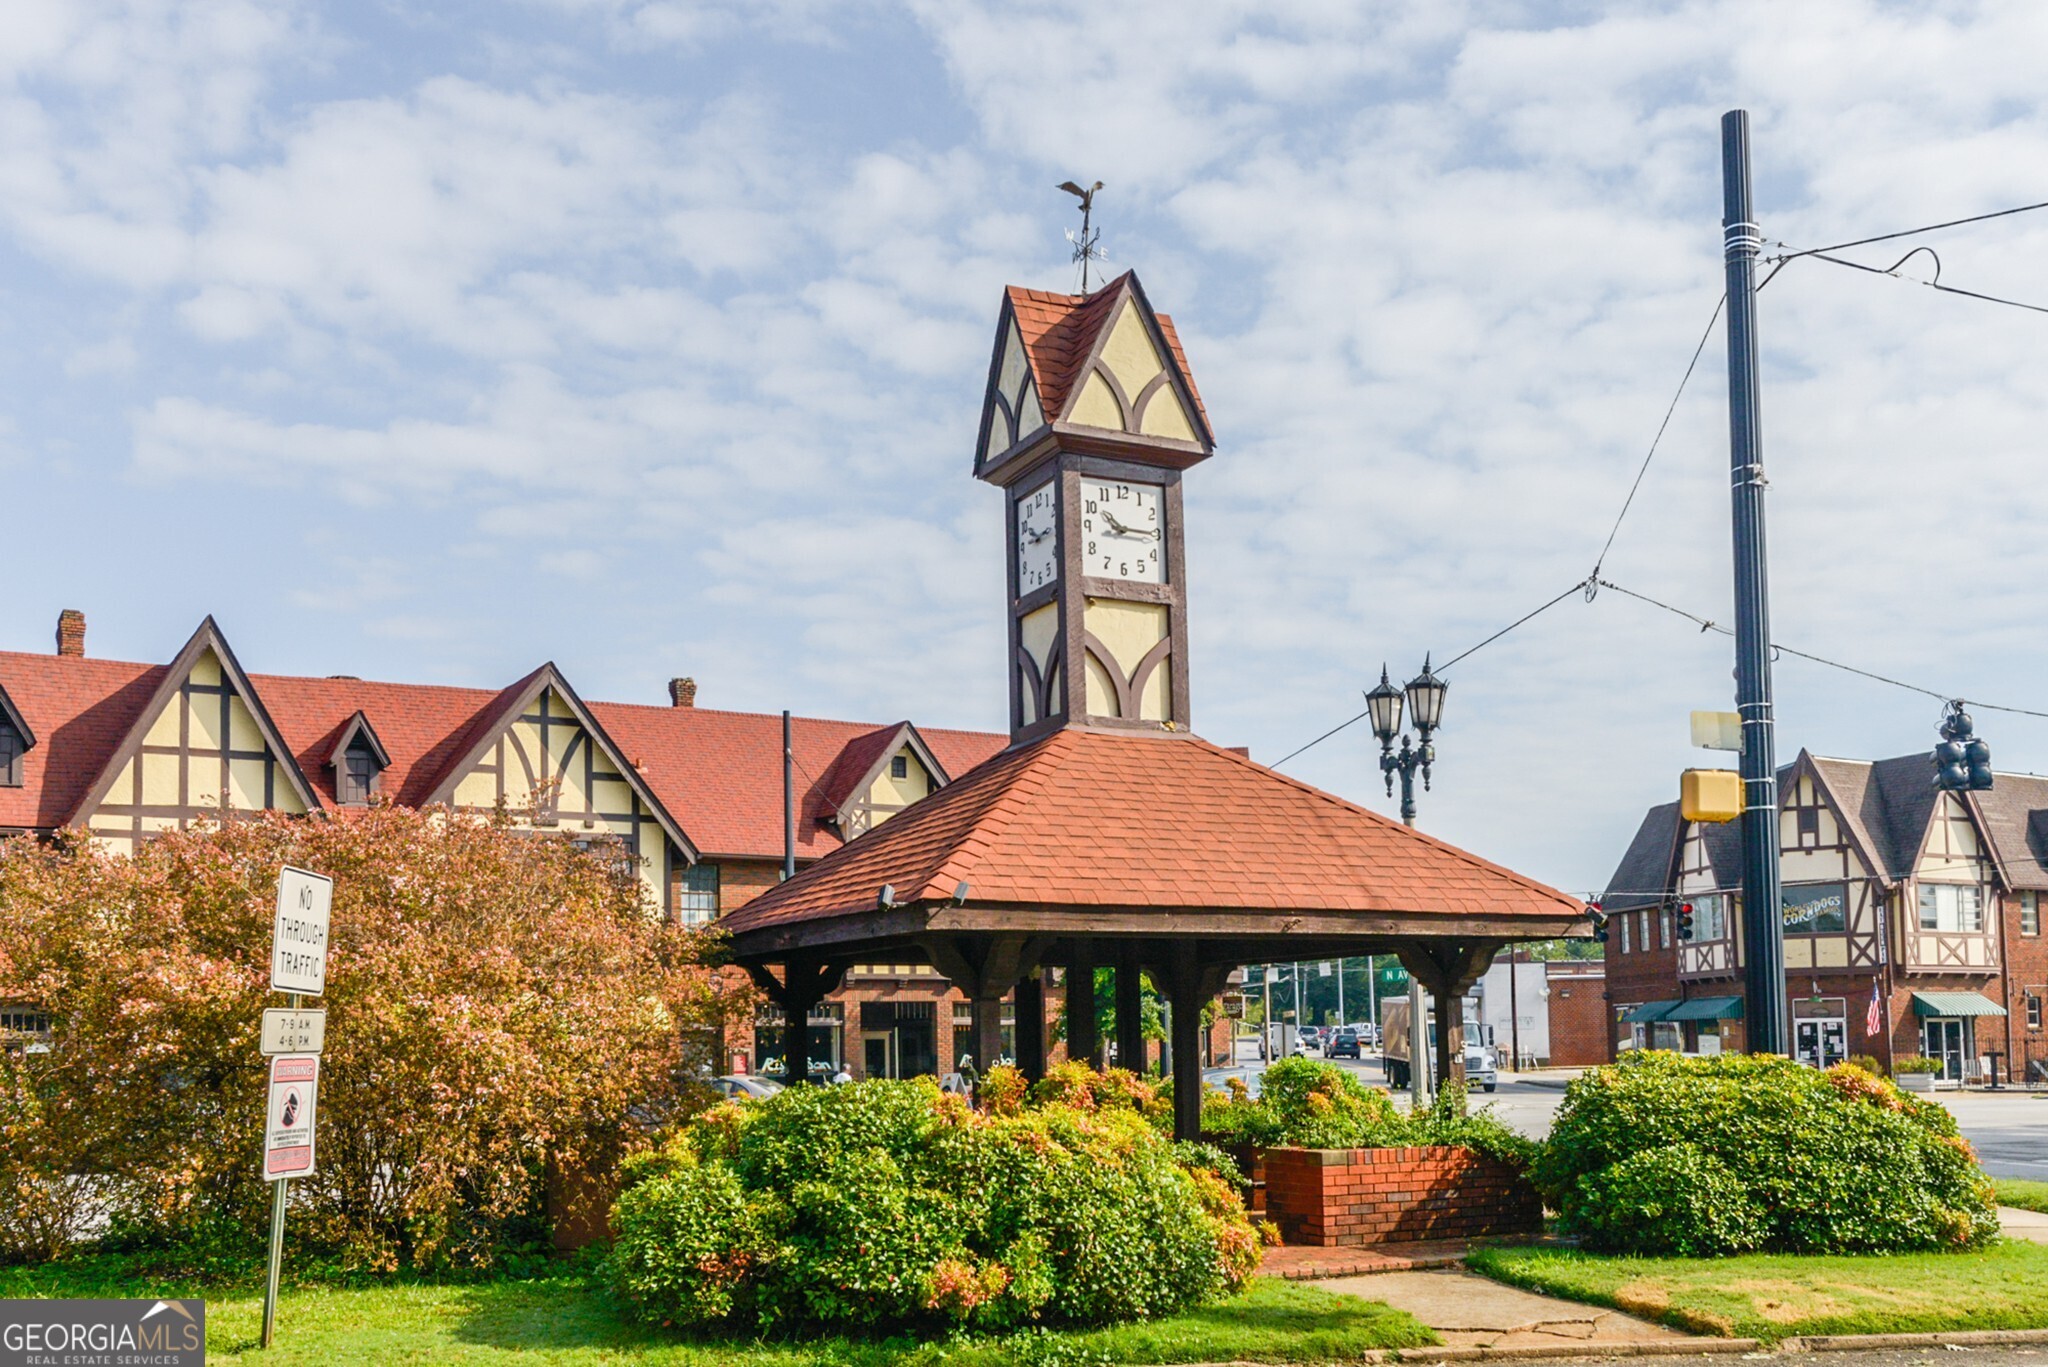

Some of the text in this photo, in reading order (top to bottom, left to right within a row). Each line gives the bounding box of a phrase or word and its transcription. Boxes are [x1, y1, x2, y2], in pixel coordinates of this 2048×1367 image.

[1064, 227, 1074, 242] W
[1100, 246, 1109, 262] E
[1099, 487, 1110, 502] 11
[1117, 485, 1129, 500] 12
[1136, 492, 1142, 506] 1
[1035, 493, 1042, 509] 12
[1085, 500, 1097, 514] 10
[1026, 503, 1033, 518] 11
[1148, 507, 1156, 520] 2
[1021, 520, 1028, 535] 10
[1084, 519, 1092, 533] 9
[1020, 542, 1025, 555] 9
[1088, 541, 1096, 555] 8
[1149, 548, 1157, 562] 4
[1022, 561, 1027, 575] 8
[1045, 562, 1051, 577] 5
[1103, 556, 1112, 570] 7
[1120, 562, 1128, 576] 6
[1136, 559, 1145, 573] 5
[1029, 571, 1035, 585] 7
[1037, 571, 1043, 585] 6
[298, 886, 313, 910] NO
[1783, 895, 1841, 926] CORNDOGS
[281, 917, 325, 946] THROUGH
[280, 951, 320, 978] TRAFFIC
[1386, 970, 1393, 980] N
[281, 1018, 295, 1030] 7-9
[279, 1035, 293, 1046] 4-6
[277, 1064, 313, 1078] WARNING
